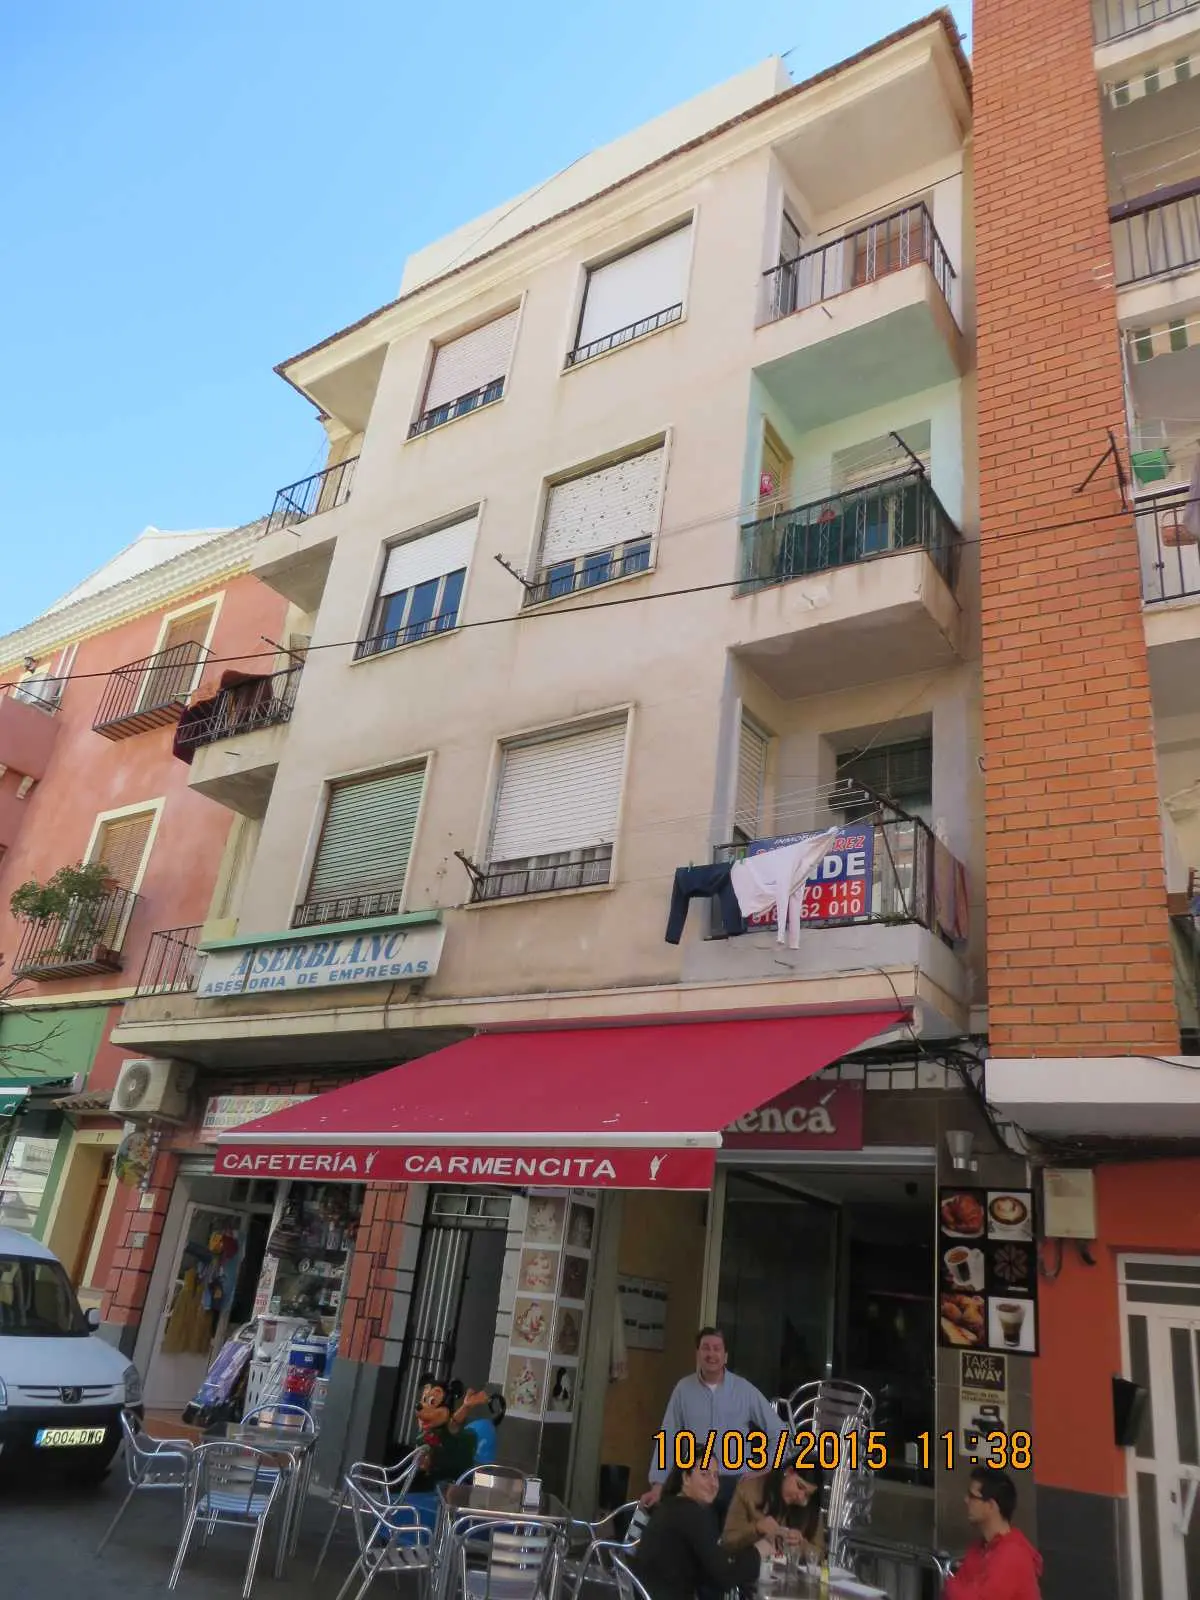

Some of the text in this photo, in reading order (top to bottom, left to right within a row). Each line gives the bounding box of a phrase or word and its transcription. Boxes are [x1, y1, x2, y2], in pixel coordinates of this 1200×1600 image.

[828, 881, 861, 898] 115
[828, 899, 861, 915] 010
[230, 932, 408, 977] ASERBLANC
[203, 960, 430, 995] ASESORIA DE EMPRESAS
[222, 1151, 618, 1180] CAFETERÍA CARMENCITA
[964, 1354, 996, 1370] TAKE
[964, 1367, 1003, 1382] AWAY
[45, 1431, 76, 1444] 5004
